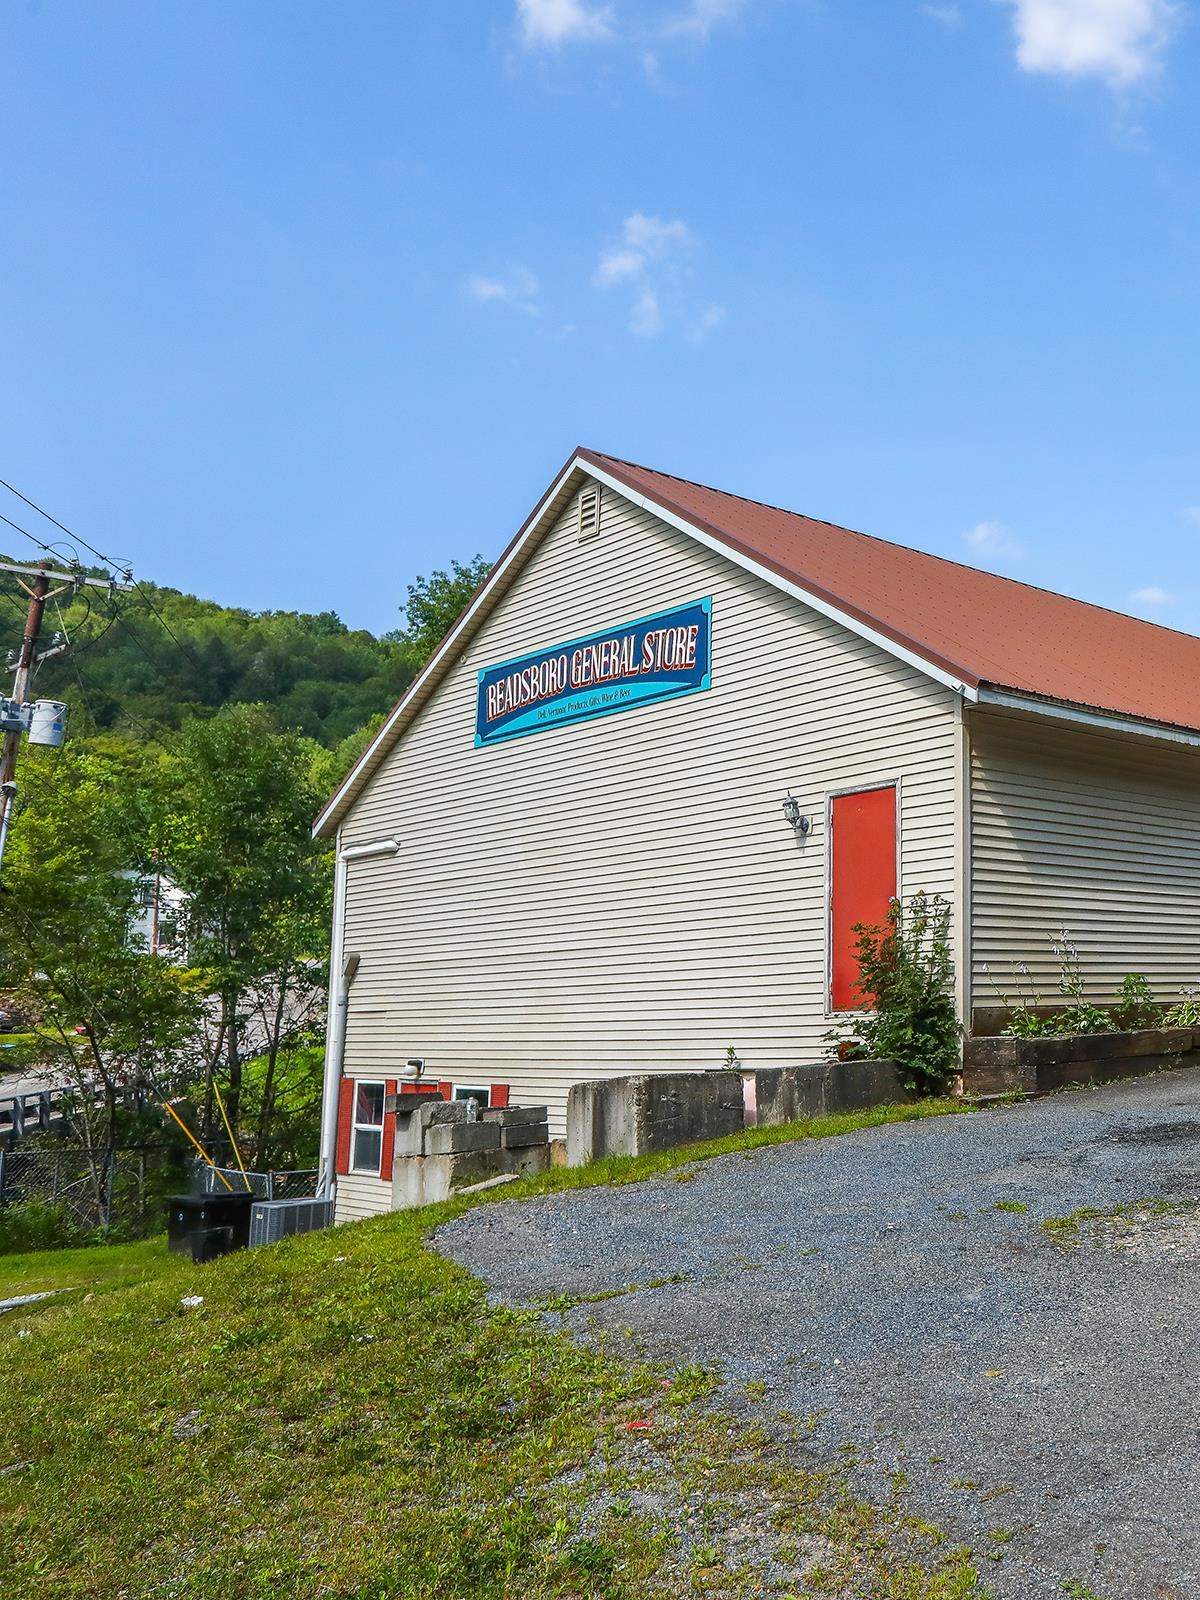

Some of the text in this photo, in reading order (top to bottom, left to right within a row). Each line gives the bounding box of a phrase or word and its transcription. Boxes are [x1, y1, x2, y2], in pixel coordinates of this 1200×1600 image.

[486, 625, 699, 722] READSBORO GENERAL STORE
